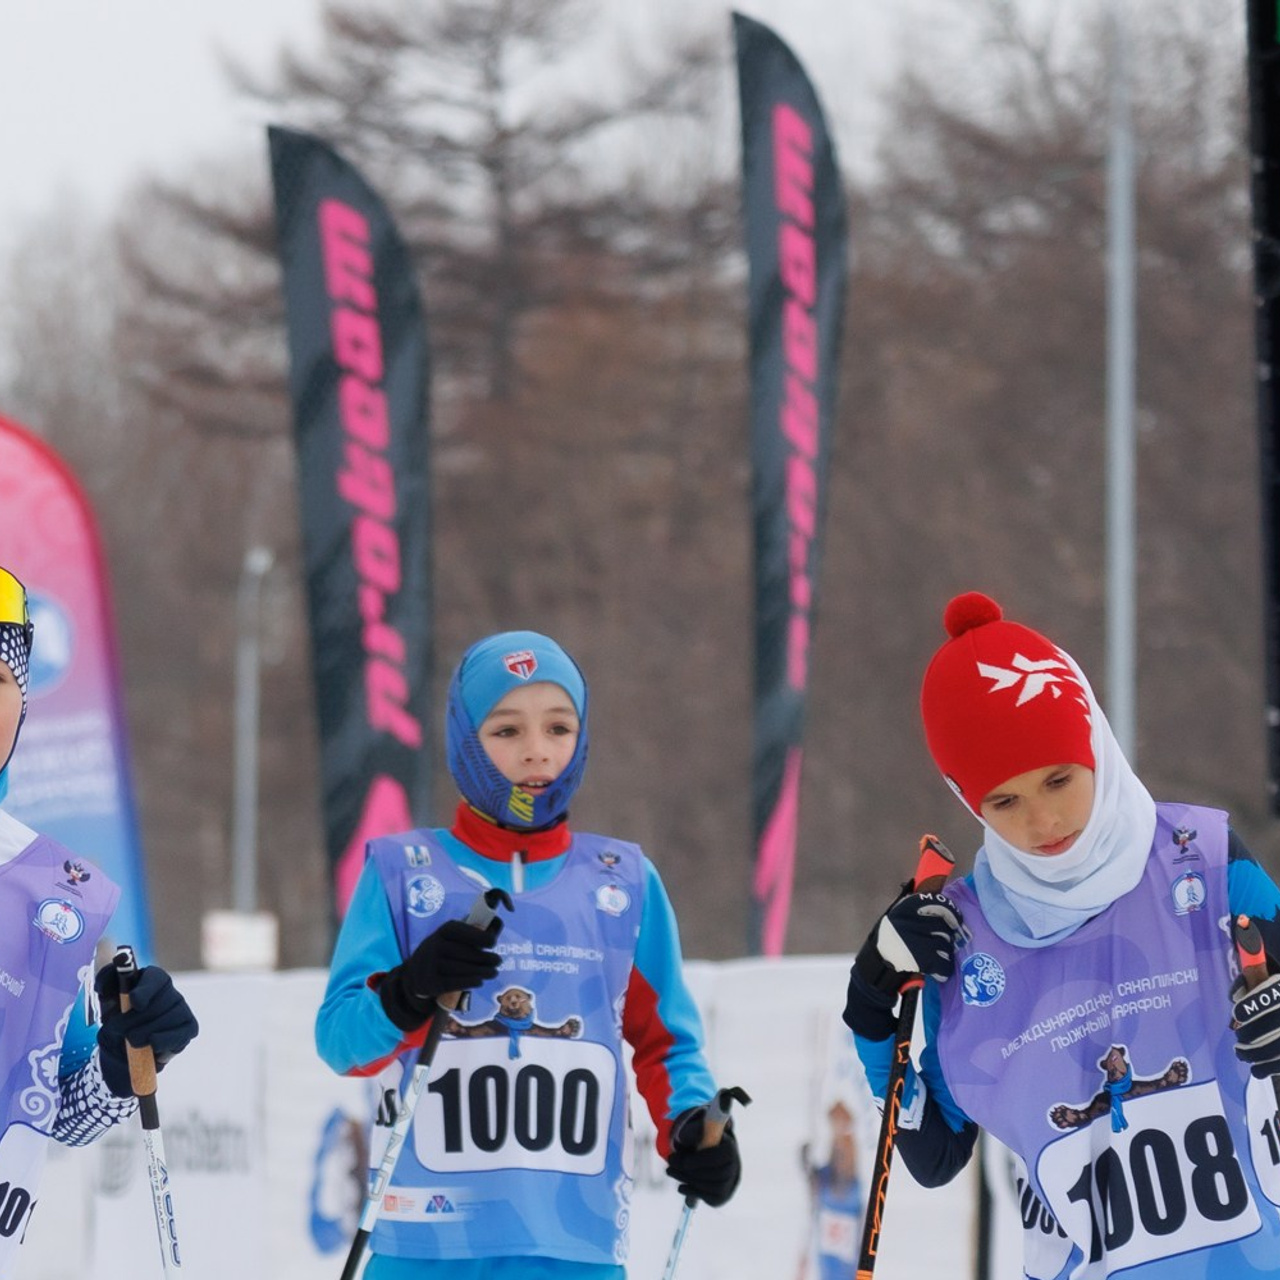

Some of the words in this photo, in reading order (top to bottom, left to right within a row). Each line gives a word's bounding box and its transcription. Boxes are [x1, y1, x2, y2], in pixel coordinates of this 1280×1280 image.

[919, 893, 960, 912] MOA
[536, 944, 604, 962] САХАЛИНСК
[1001, 990, 1114, 1059] МЕЖДУНАРОДНЫ
[1117, 967, 1199, 997] САХАЛИНСКИ
[1243, 983, 1280, 1015] MOA
[1050, 1011, 1111, 1053] ЛЫЖНЫЙ
[427, 1063, 600, 1156] 1000
[1066, 1114, 1249, 1265] 1008
